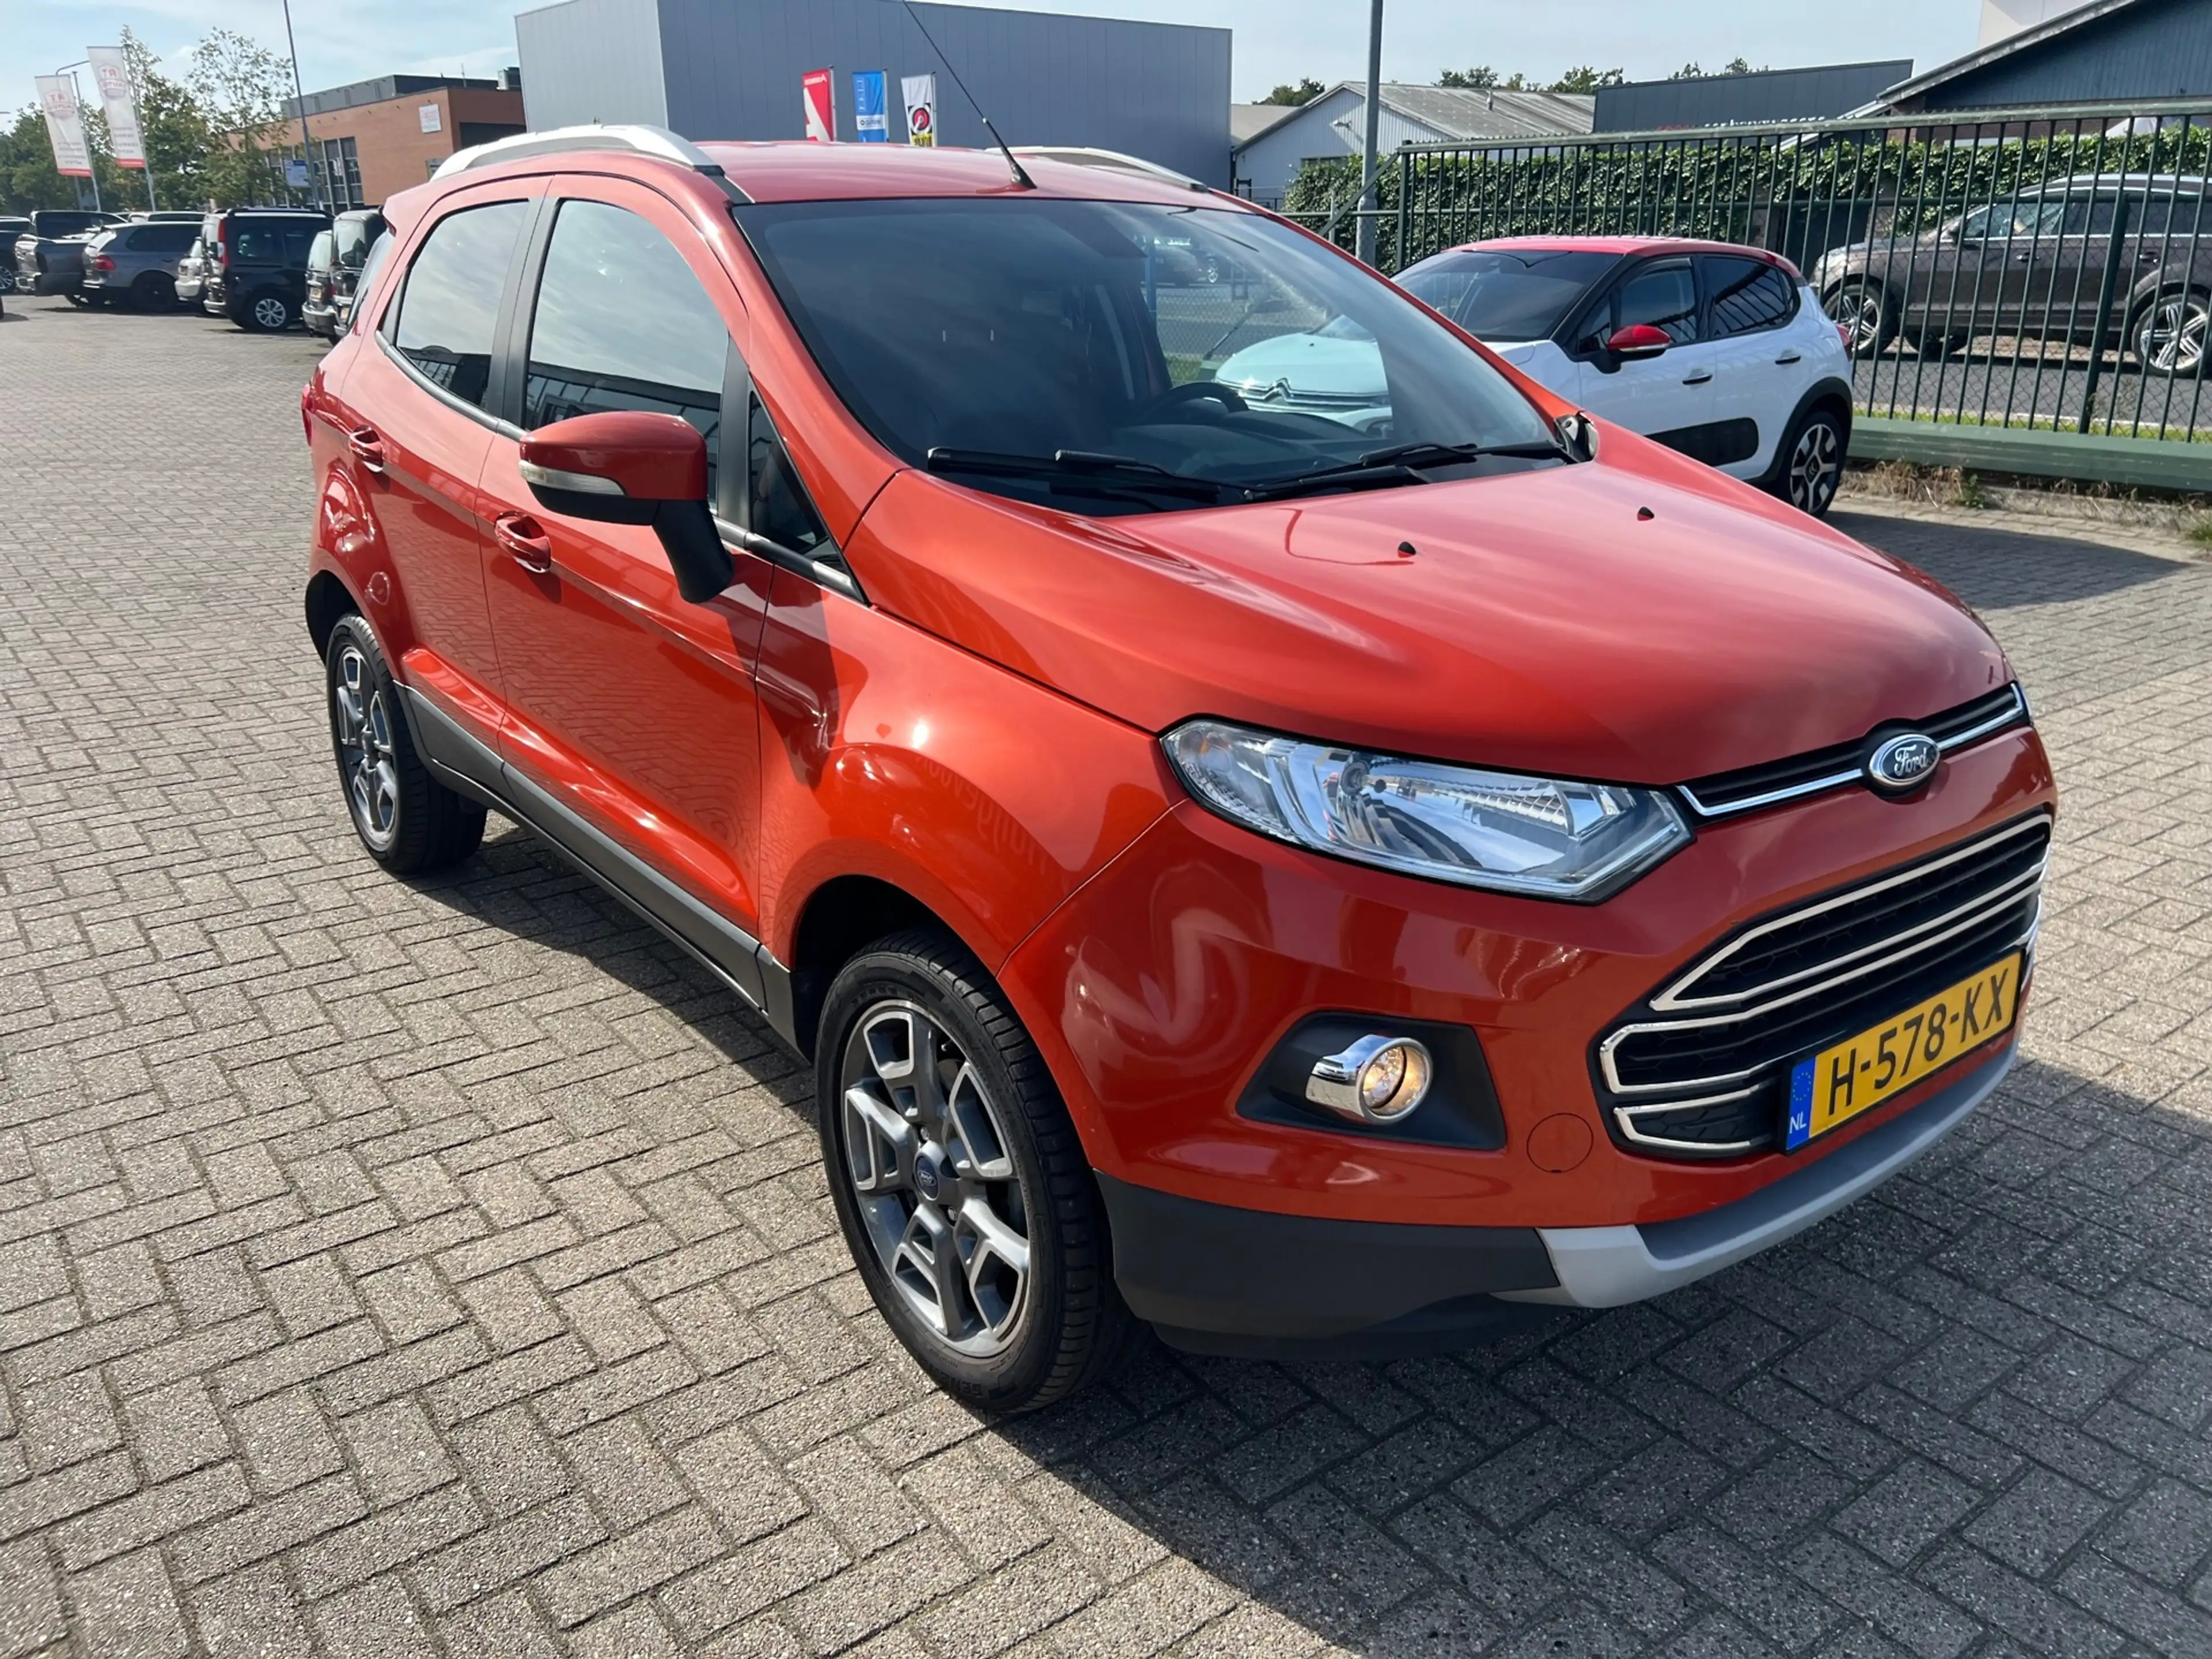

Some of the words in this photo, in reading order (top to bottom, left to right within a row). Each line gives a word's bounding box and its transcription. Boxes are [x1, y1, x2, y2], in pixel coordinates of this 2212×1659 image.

[1894, 744, 1927, 777] Ford
[1828, 968, 2009, 1117] H-578-KX
[1789, 1111, 1807, 1134] NL
